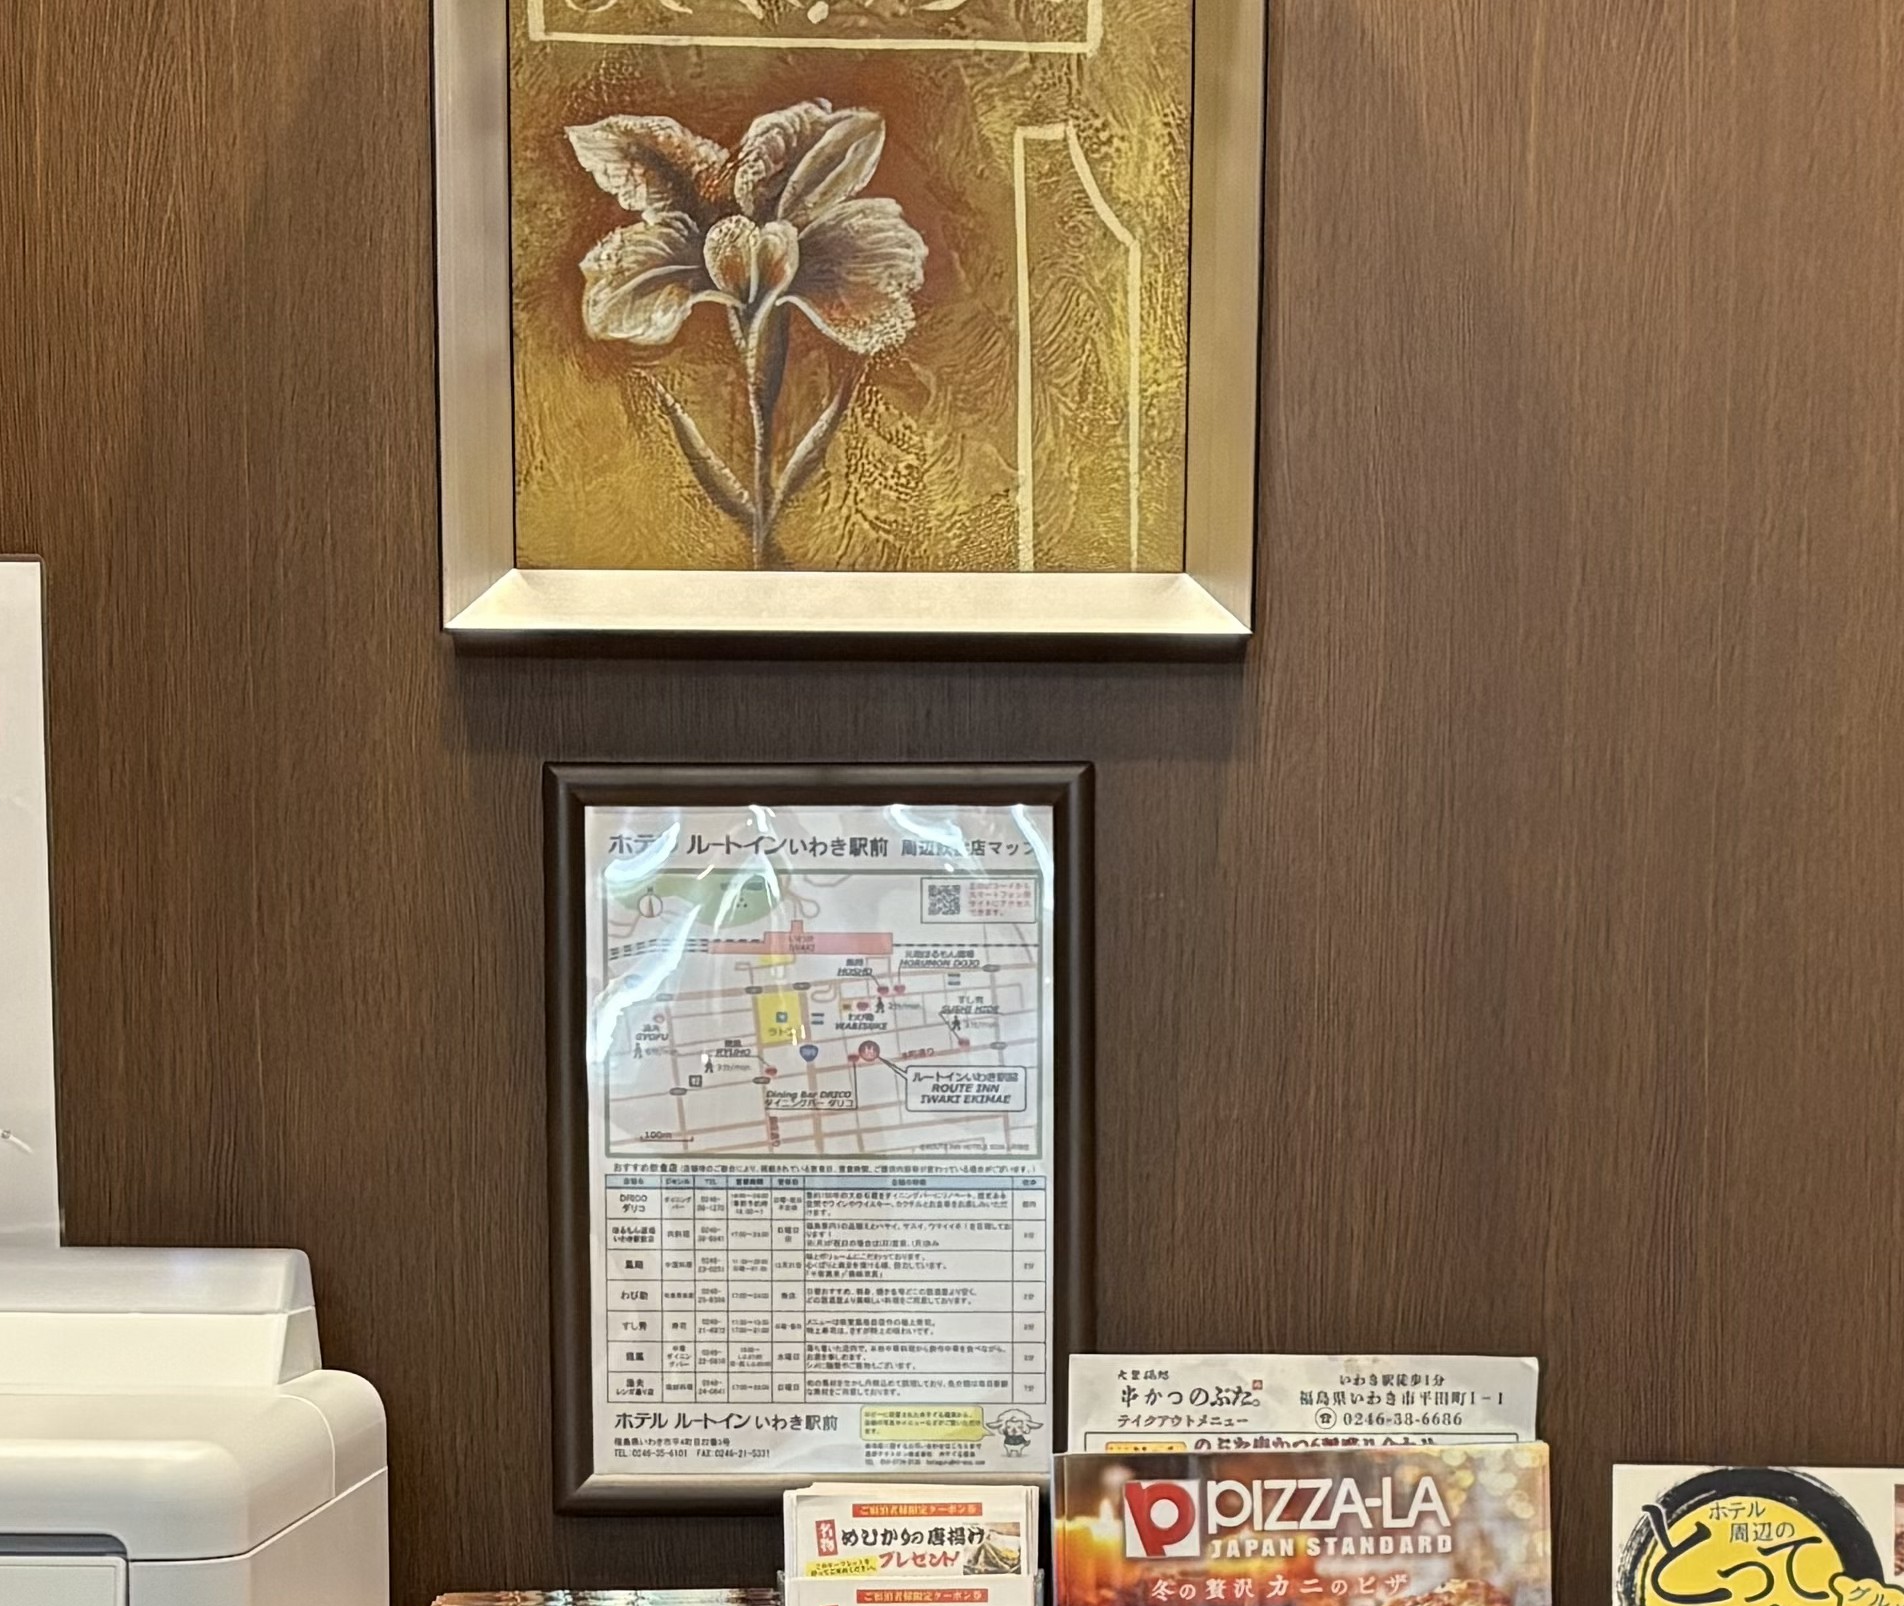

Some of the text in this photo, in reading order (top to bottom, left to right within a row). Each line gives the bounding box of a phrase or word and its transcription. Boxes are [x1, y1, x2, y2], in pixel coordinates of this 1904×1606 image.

[932, 1083, 1000, 1093] ROUTE INN
[614, 1412, 669, 1430] ホテル
[1117, 1414, 1249, 1428] テイクアウトメニュー
[1708, 1502, 1766, 1520] ホテル
[1728, 1521, 1796, 1545] 周辺の
[1211, 1534, 1453, 1559] JAPAN STANDARD
[1642, 1504, 1830, 1605] とって
